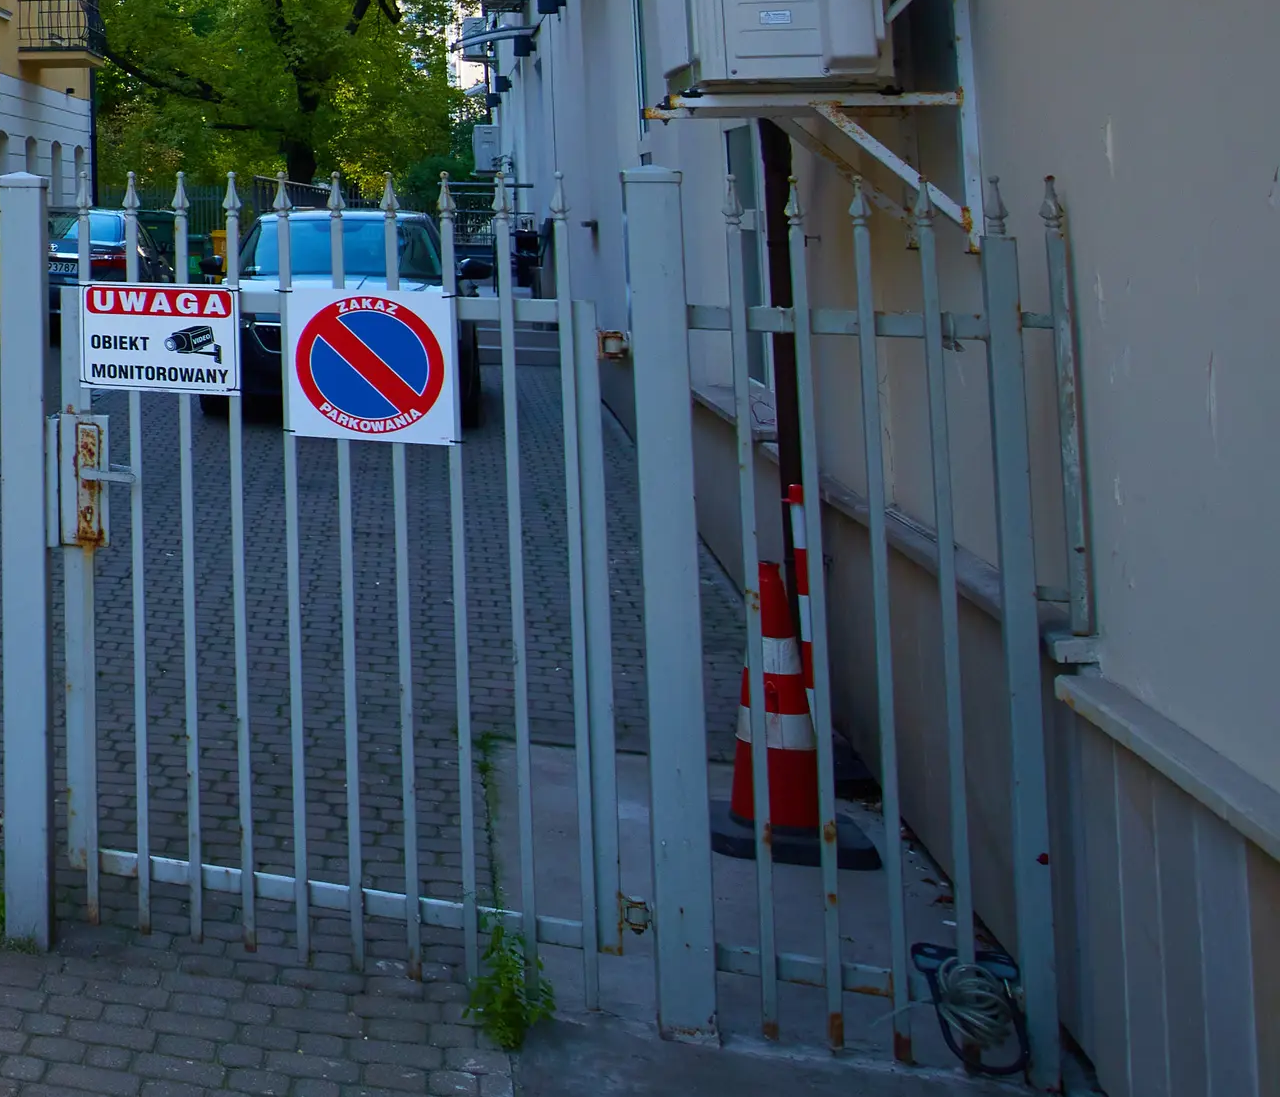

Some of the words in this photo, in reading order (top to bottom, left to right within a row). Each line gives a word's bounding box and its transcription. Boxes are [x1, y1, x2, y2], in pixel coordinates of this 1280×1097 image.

[92, 290, 227, 315] UWAGA
[336, 298, 399, 315] ZAKAZ
[90, 334, 150, 351] OBIEKT
[192, 333, 211, 346] VIDEO
[91, 363, 229, 384] MONITOROWANY
[319, 402, 423, 432] PARKOWANIA
